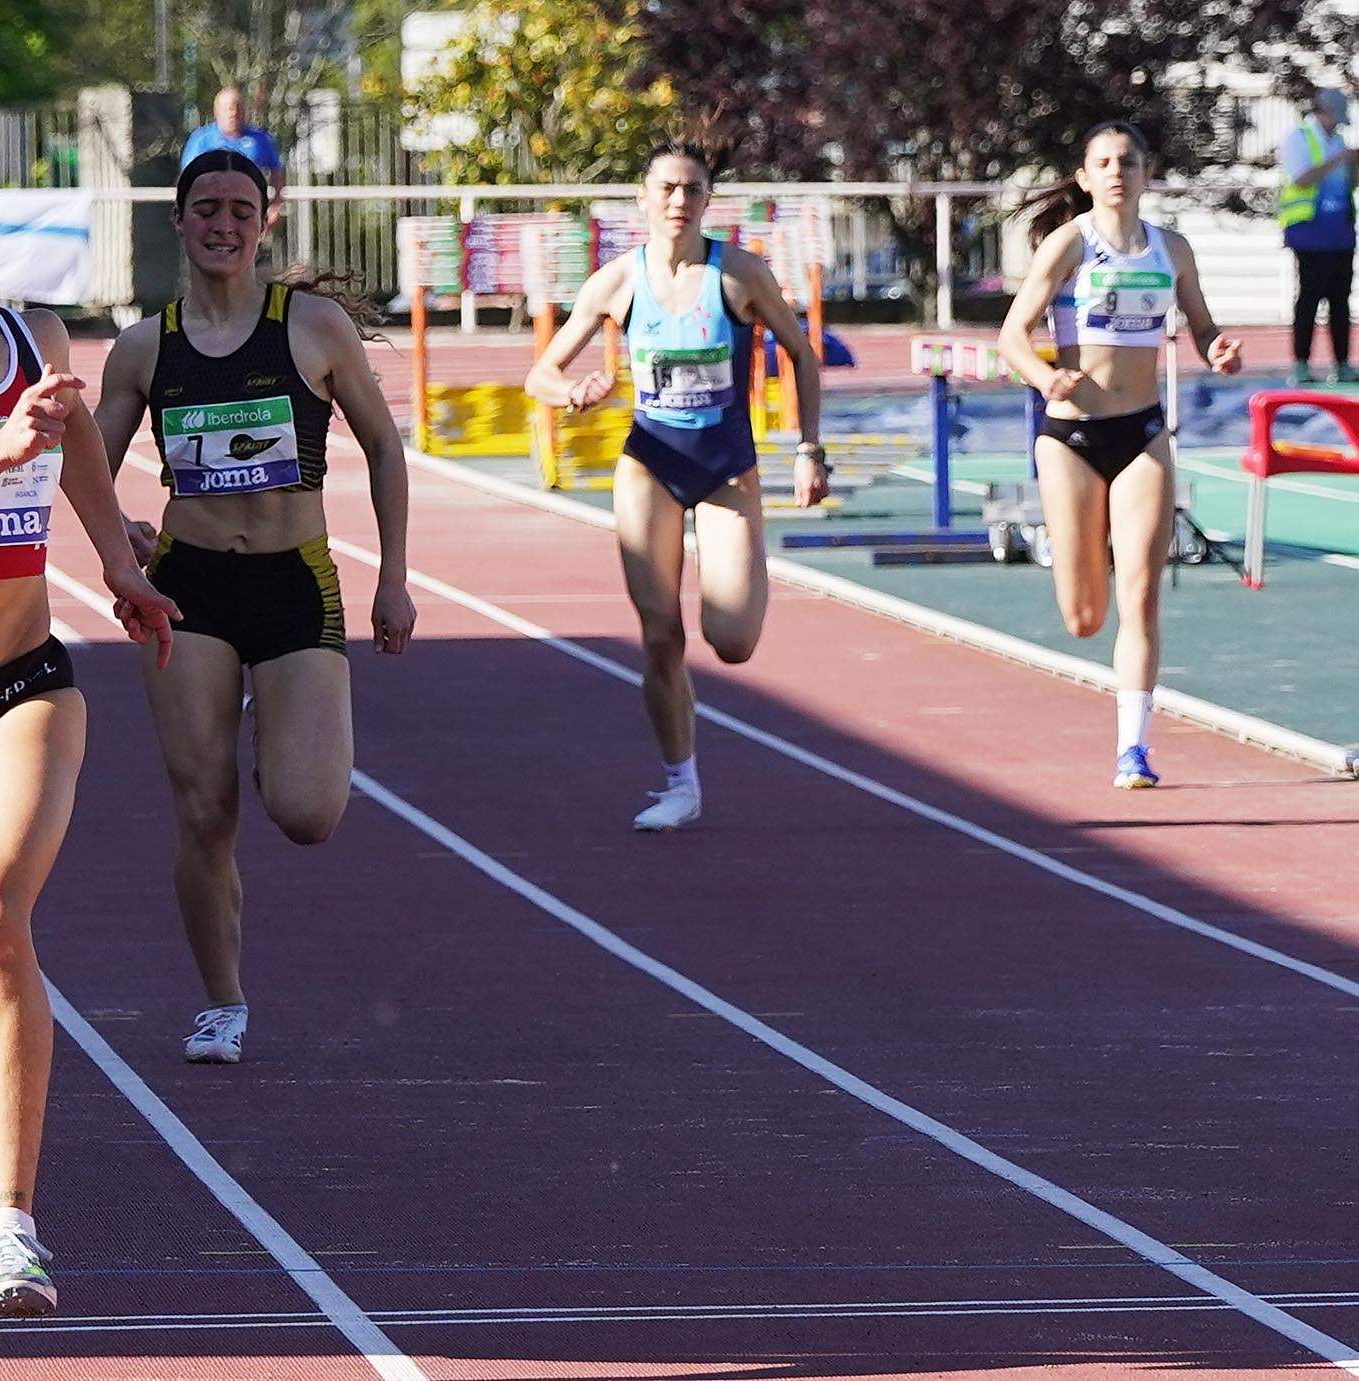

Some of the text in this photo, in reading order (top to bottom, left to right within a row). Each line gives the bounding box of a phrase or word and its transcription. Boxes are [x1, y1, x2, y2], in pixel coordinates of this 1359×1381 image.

[207, 408, 272, 426] Iberdrola
[187, 435, 203, 467] 7
[200, 466, 269, 491] Joma
